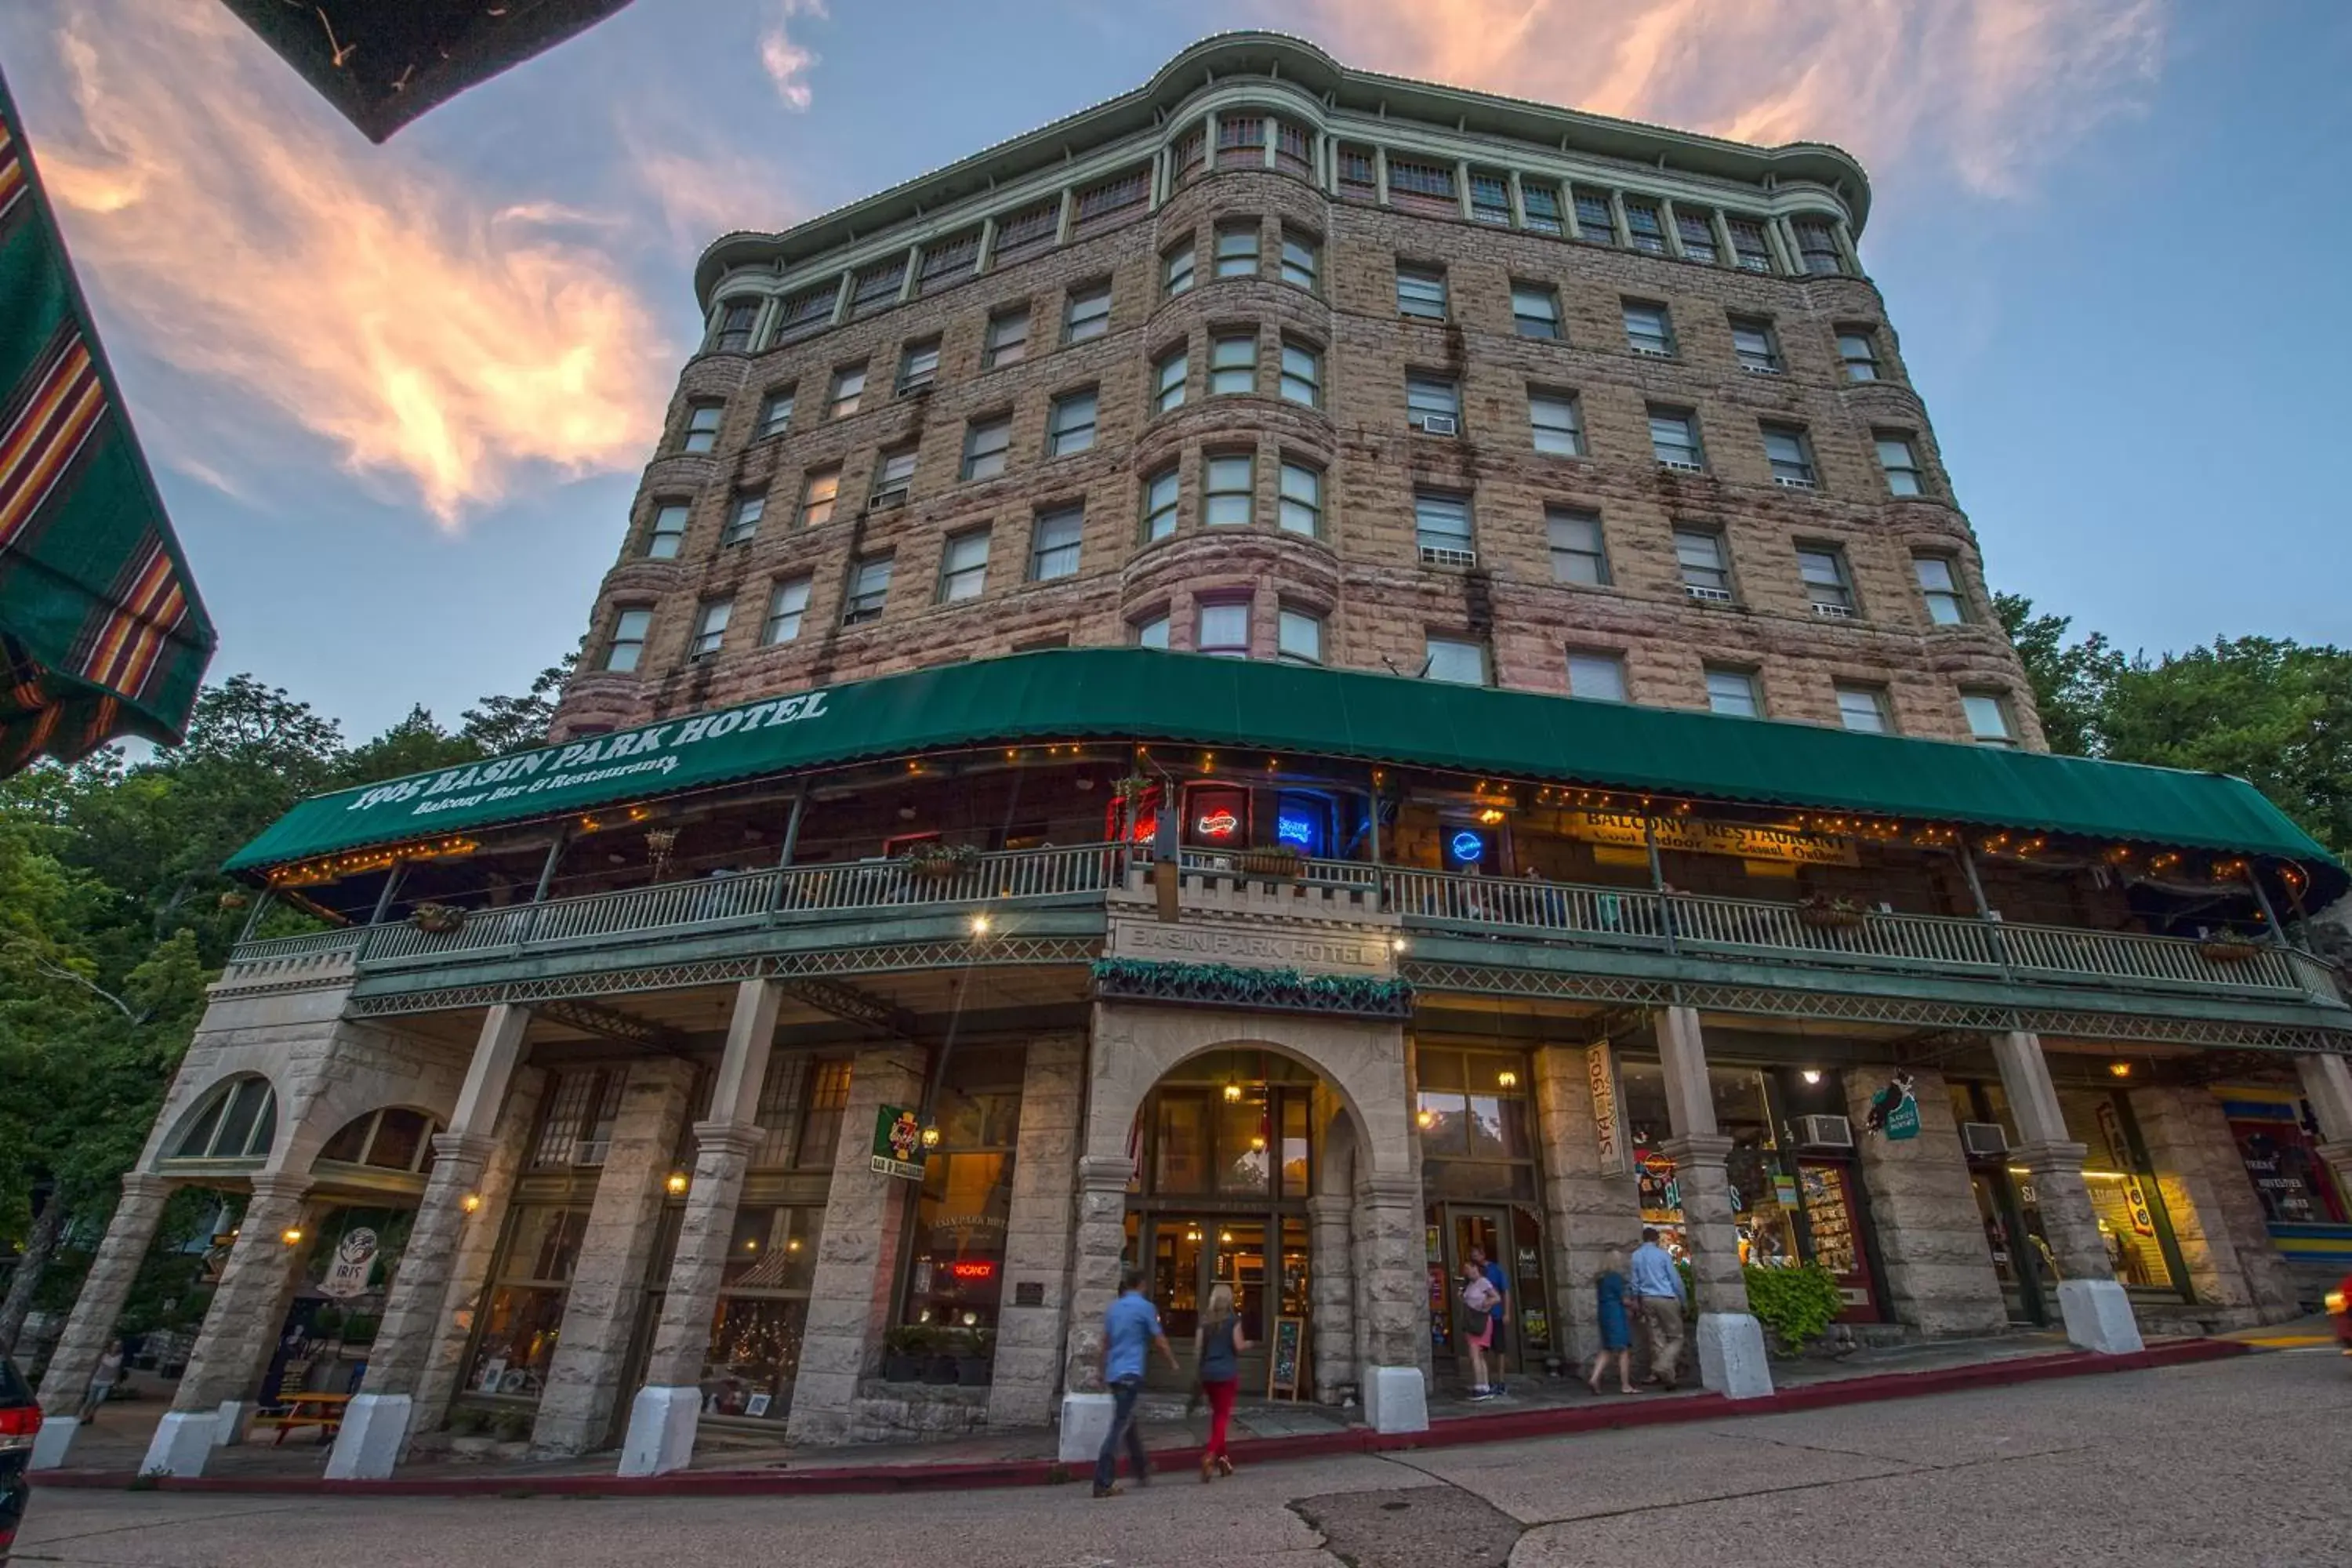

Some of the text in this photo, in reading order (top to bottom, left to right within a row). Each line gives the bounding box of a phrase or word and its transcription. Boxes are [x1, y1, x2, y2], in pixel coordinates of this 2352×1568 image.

[347, 692, 827, 810] 1905 BASIN PARK HOTEL
[486, 786, 528, 801] Bar
[1704, 824, 1845, 849] RESTAURANT
[1132, 930, 1377, 966] BASIN PARK HOTEL
[1589, 1051, 1605, 1098] 1905
[1596, 1116, 1613, 1156] SPA
[956, 1265, 991, 1276] VACANCY
